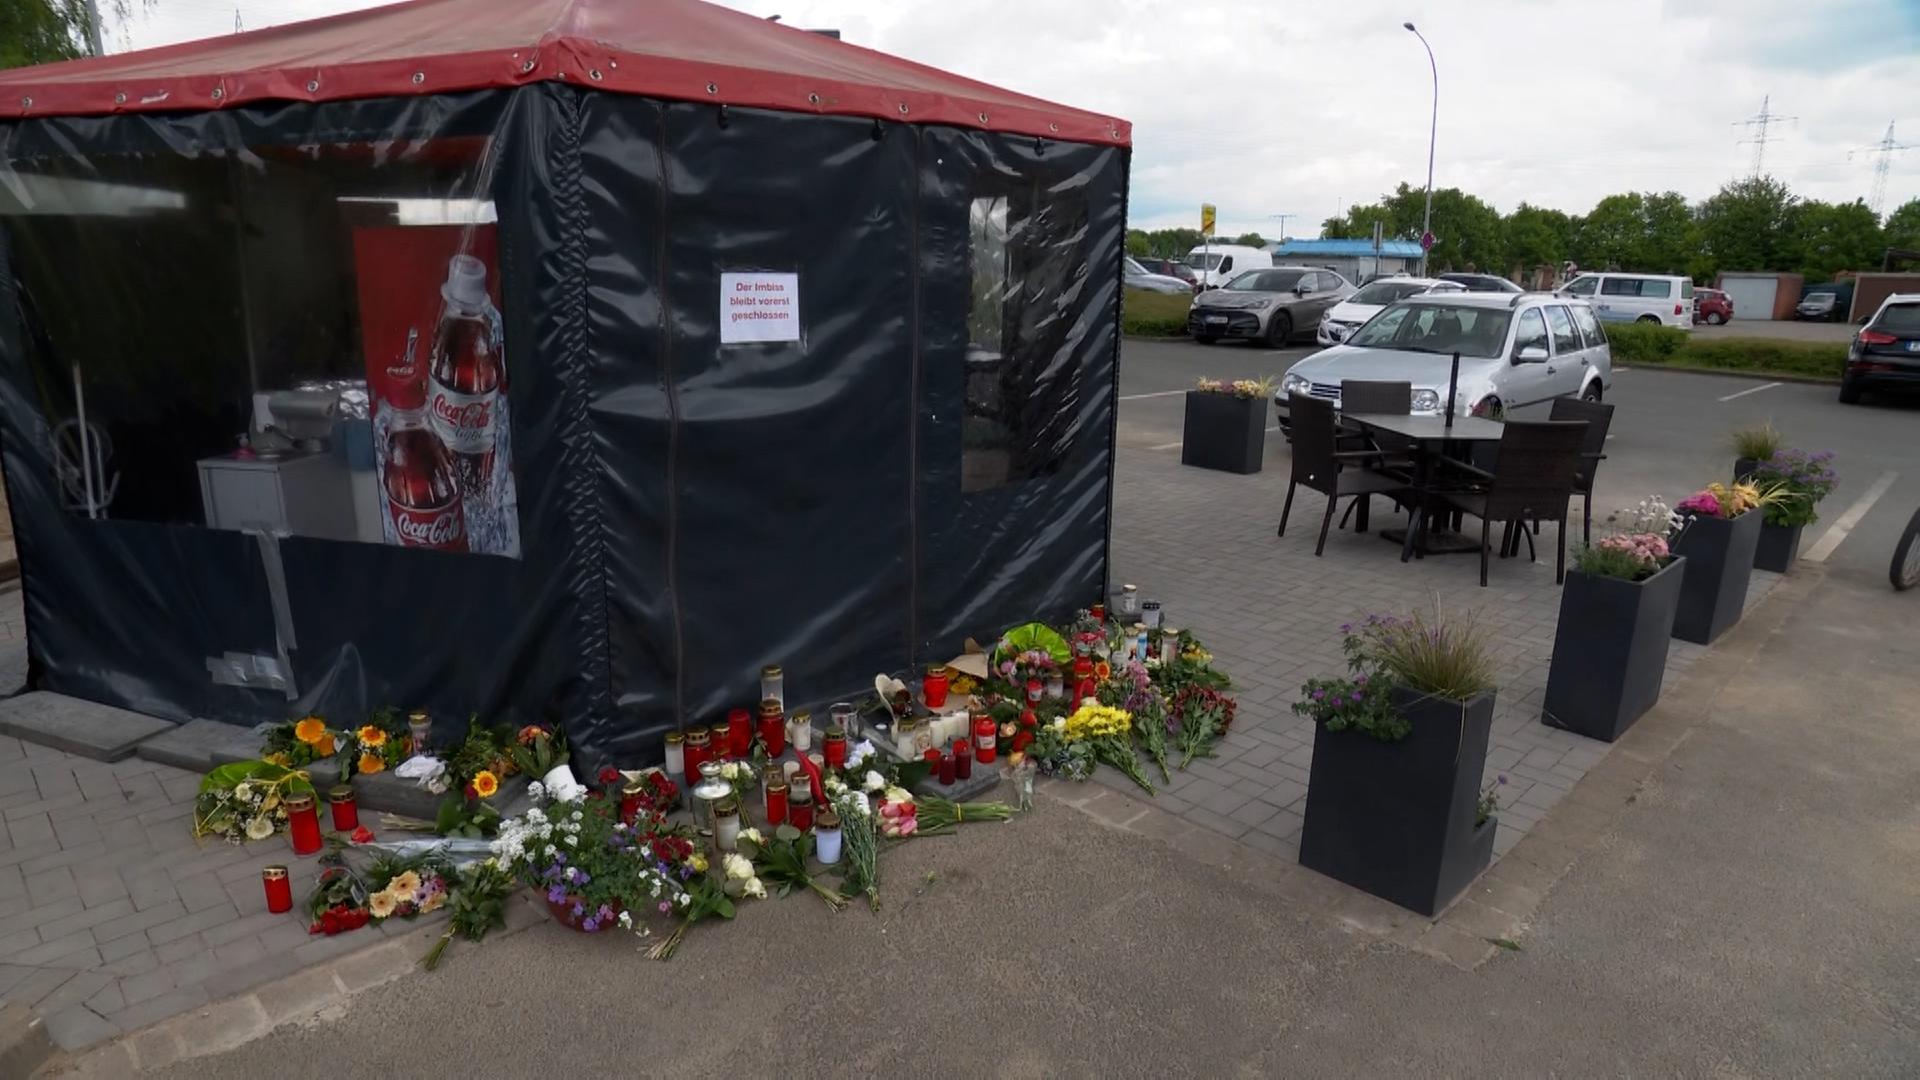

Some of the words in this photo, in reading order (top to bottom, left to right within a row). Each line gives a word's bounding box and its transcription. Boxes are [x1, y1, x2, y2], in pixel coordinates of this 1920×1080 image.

[736, 283, 752, 291] Der
[755, 283, 784, 291] Imbiss
[730, 297, 756, 305] bleibt
[731, 311, 789, 322] geschlossen
[433, 392, 490, 428] Coca-Cola
[398, 513, 459, 544] Coca-Cola
